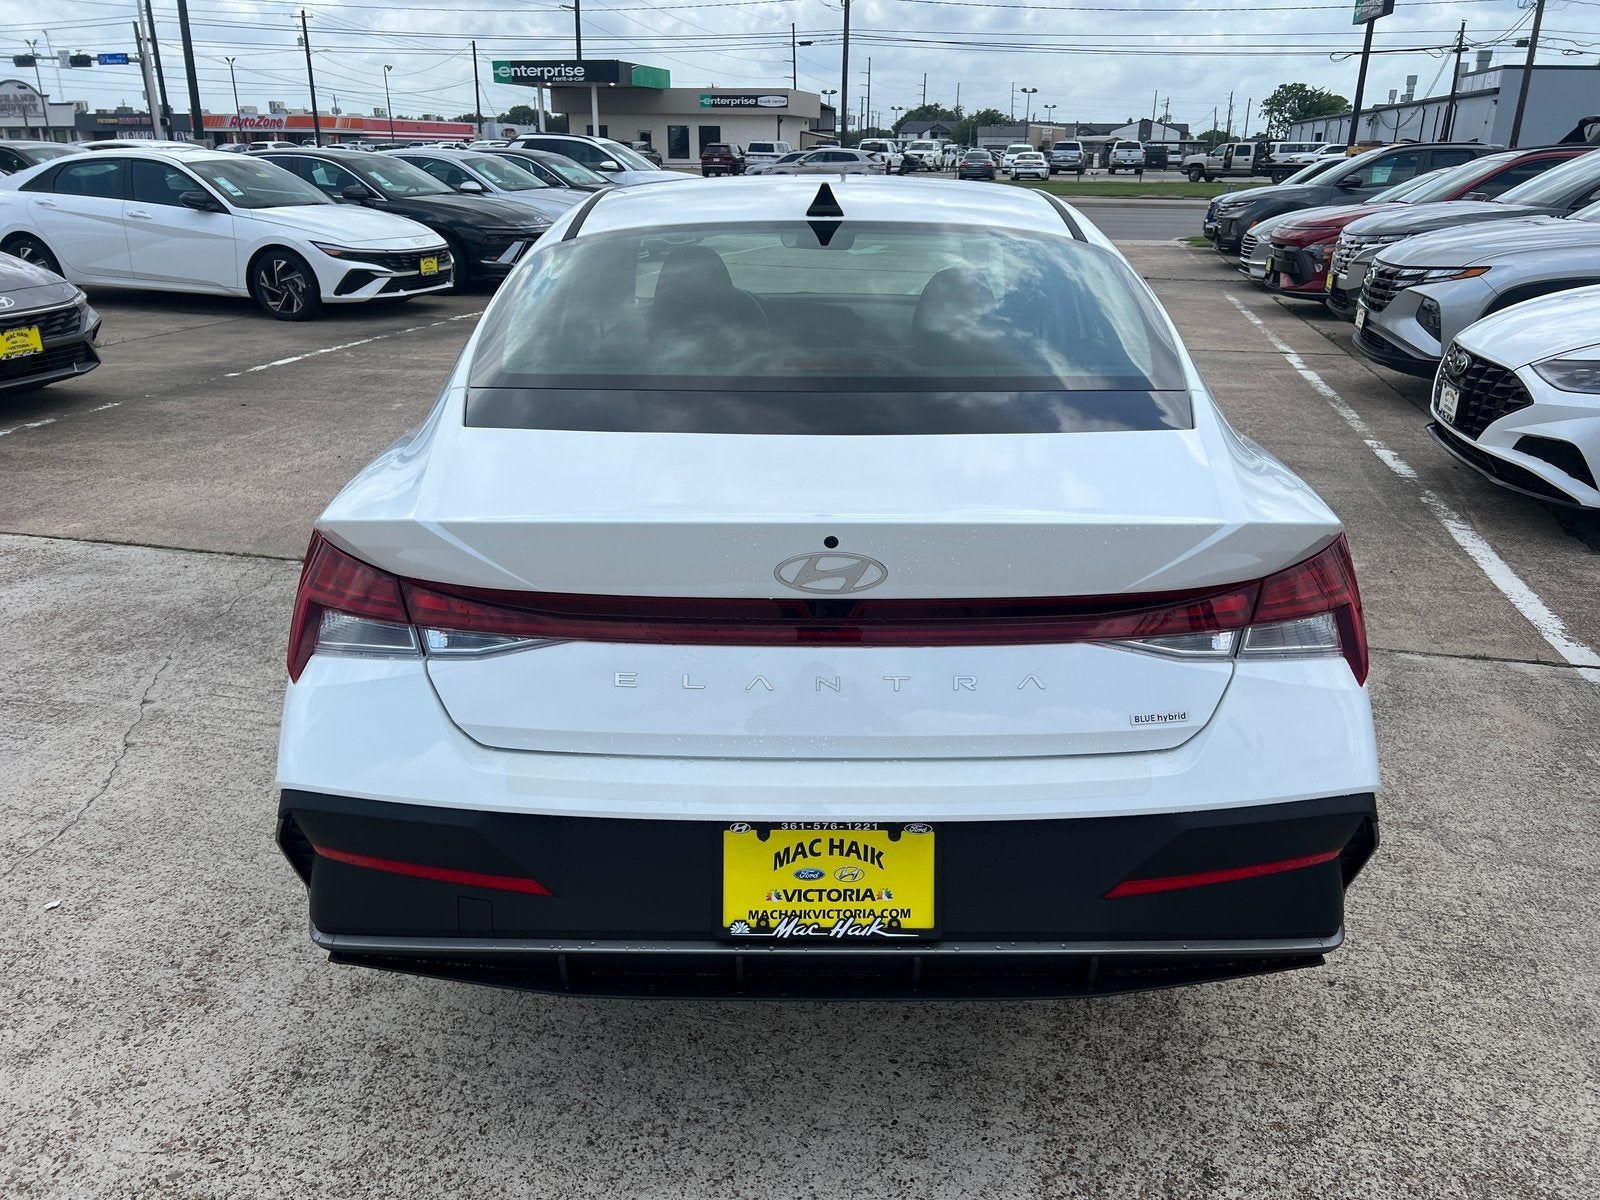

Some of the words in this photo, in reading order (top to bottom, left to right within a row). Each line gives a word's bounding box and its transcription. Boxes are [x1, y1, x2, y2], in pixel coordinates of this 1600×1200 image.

[495, 64, 585, 79] enterprise
[701, 97, 756, 106] enterprise
[229, 115, 284, 128] AutoZone
[614, 672, 1046, 693] ELANTRA
[1134, 715, 1156, 723] BLUE
[1157, 712, 1186, 722] hybrid
[781, 822, 878, 830] 361-576-1221
[907, 824, 930, 833] Ford
[773, 838, 822, 871] MAC
[828, 838, 885, 870] HAIK
[797, 869, 821, 879] Ford
[782, 888, 876, 902] VICTORIA
[748, 908, 911, 919] MACHAIKVICTORIACOM
[773, 917, 827, 938] Mac
[829, 917, 886, 938] Haik
